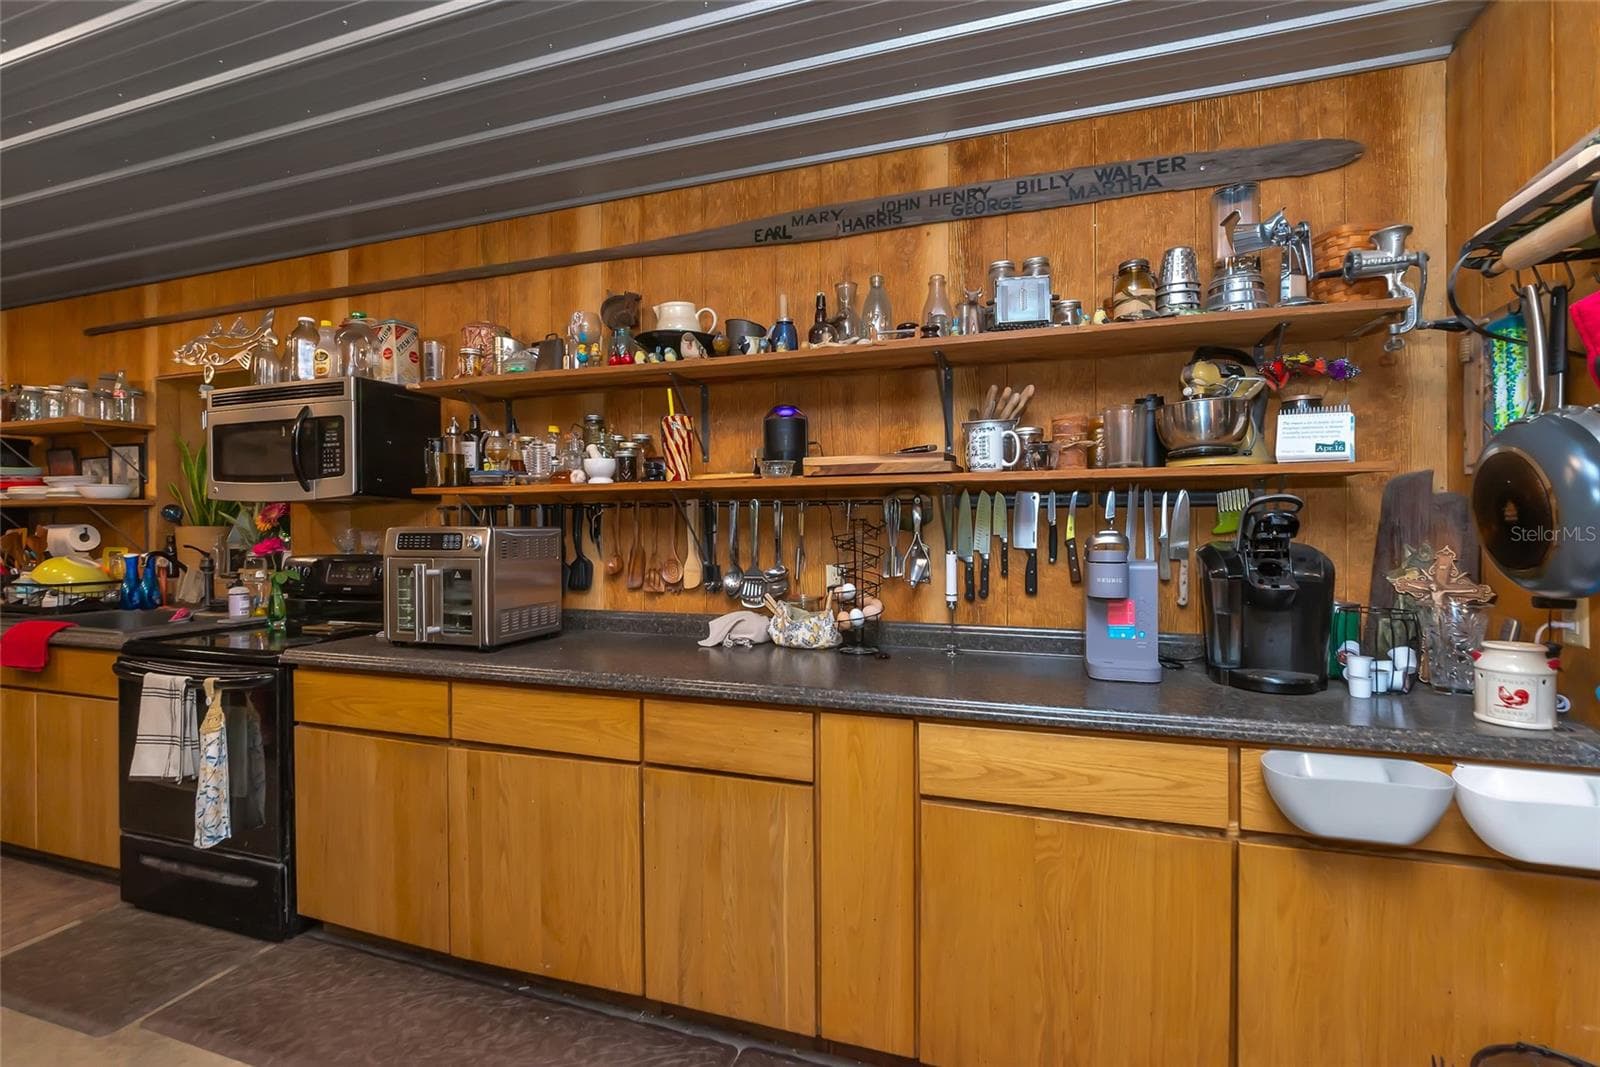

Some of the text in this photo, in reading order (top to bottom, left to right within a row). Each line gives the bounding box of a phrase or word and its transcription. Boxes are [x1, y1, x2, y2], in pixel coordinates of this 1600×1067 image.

[754, 176, 1162, 243] EARL HARRIS GEORGE MARTHA
[791, 156, 1187, 227] MARY JOHN HENRY BILLY WALTER
